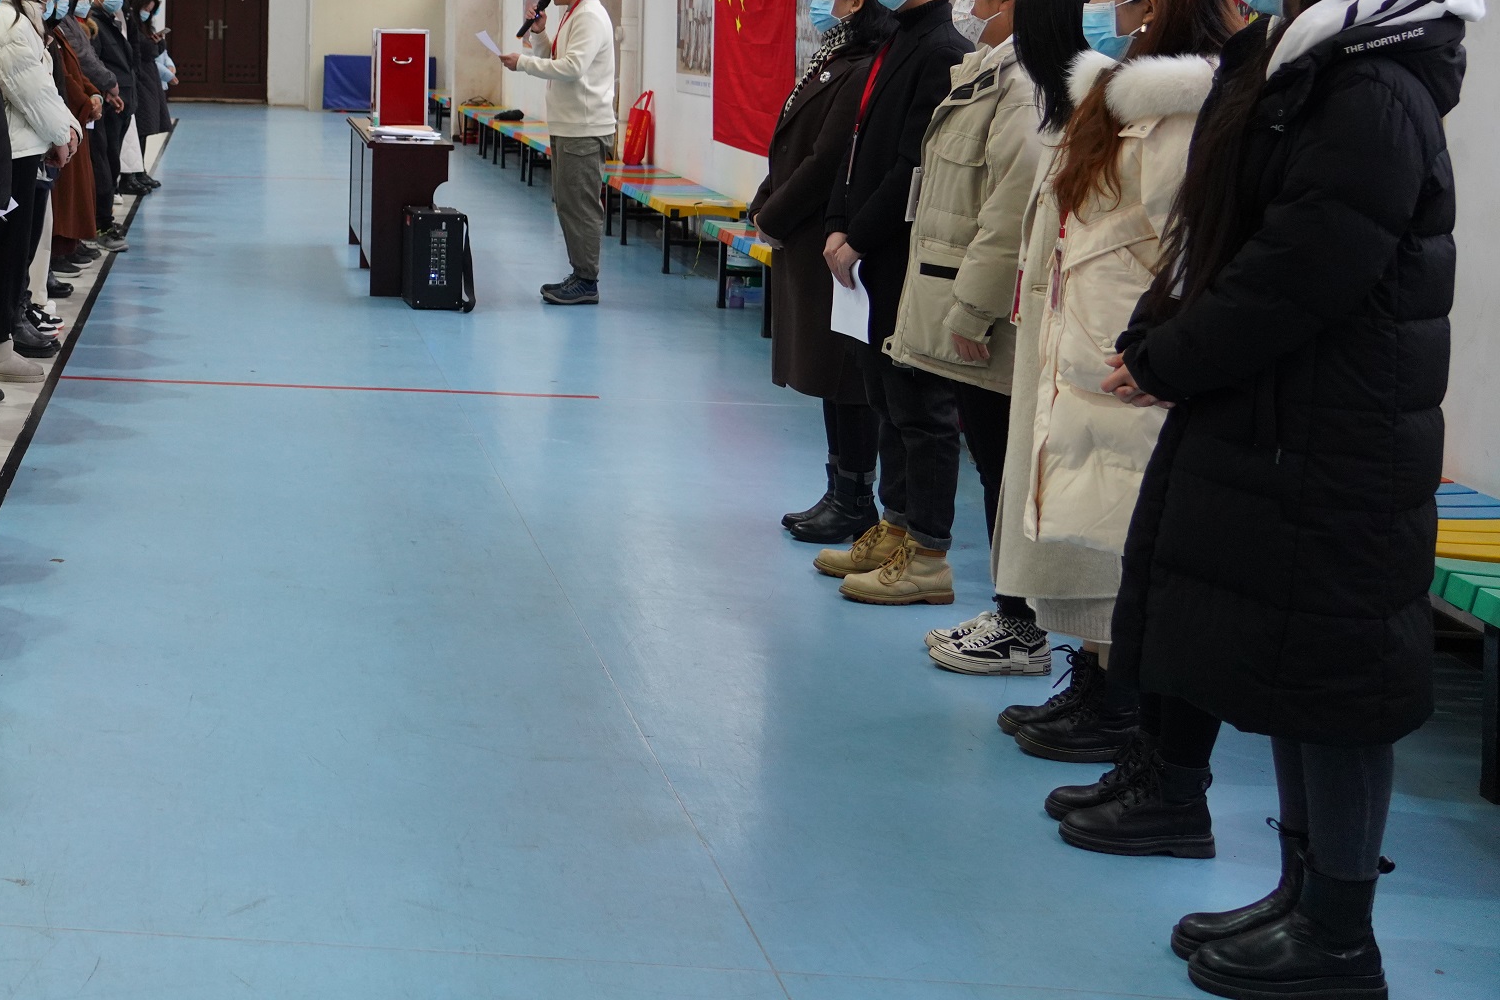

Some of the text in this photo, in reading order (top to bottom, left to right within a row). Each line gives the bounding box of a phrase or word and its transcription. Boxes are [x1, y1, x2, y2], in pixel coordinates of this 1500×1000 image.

[1344, 27, 1425, 54] THE NORTH FACE
